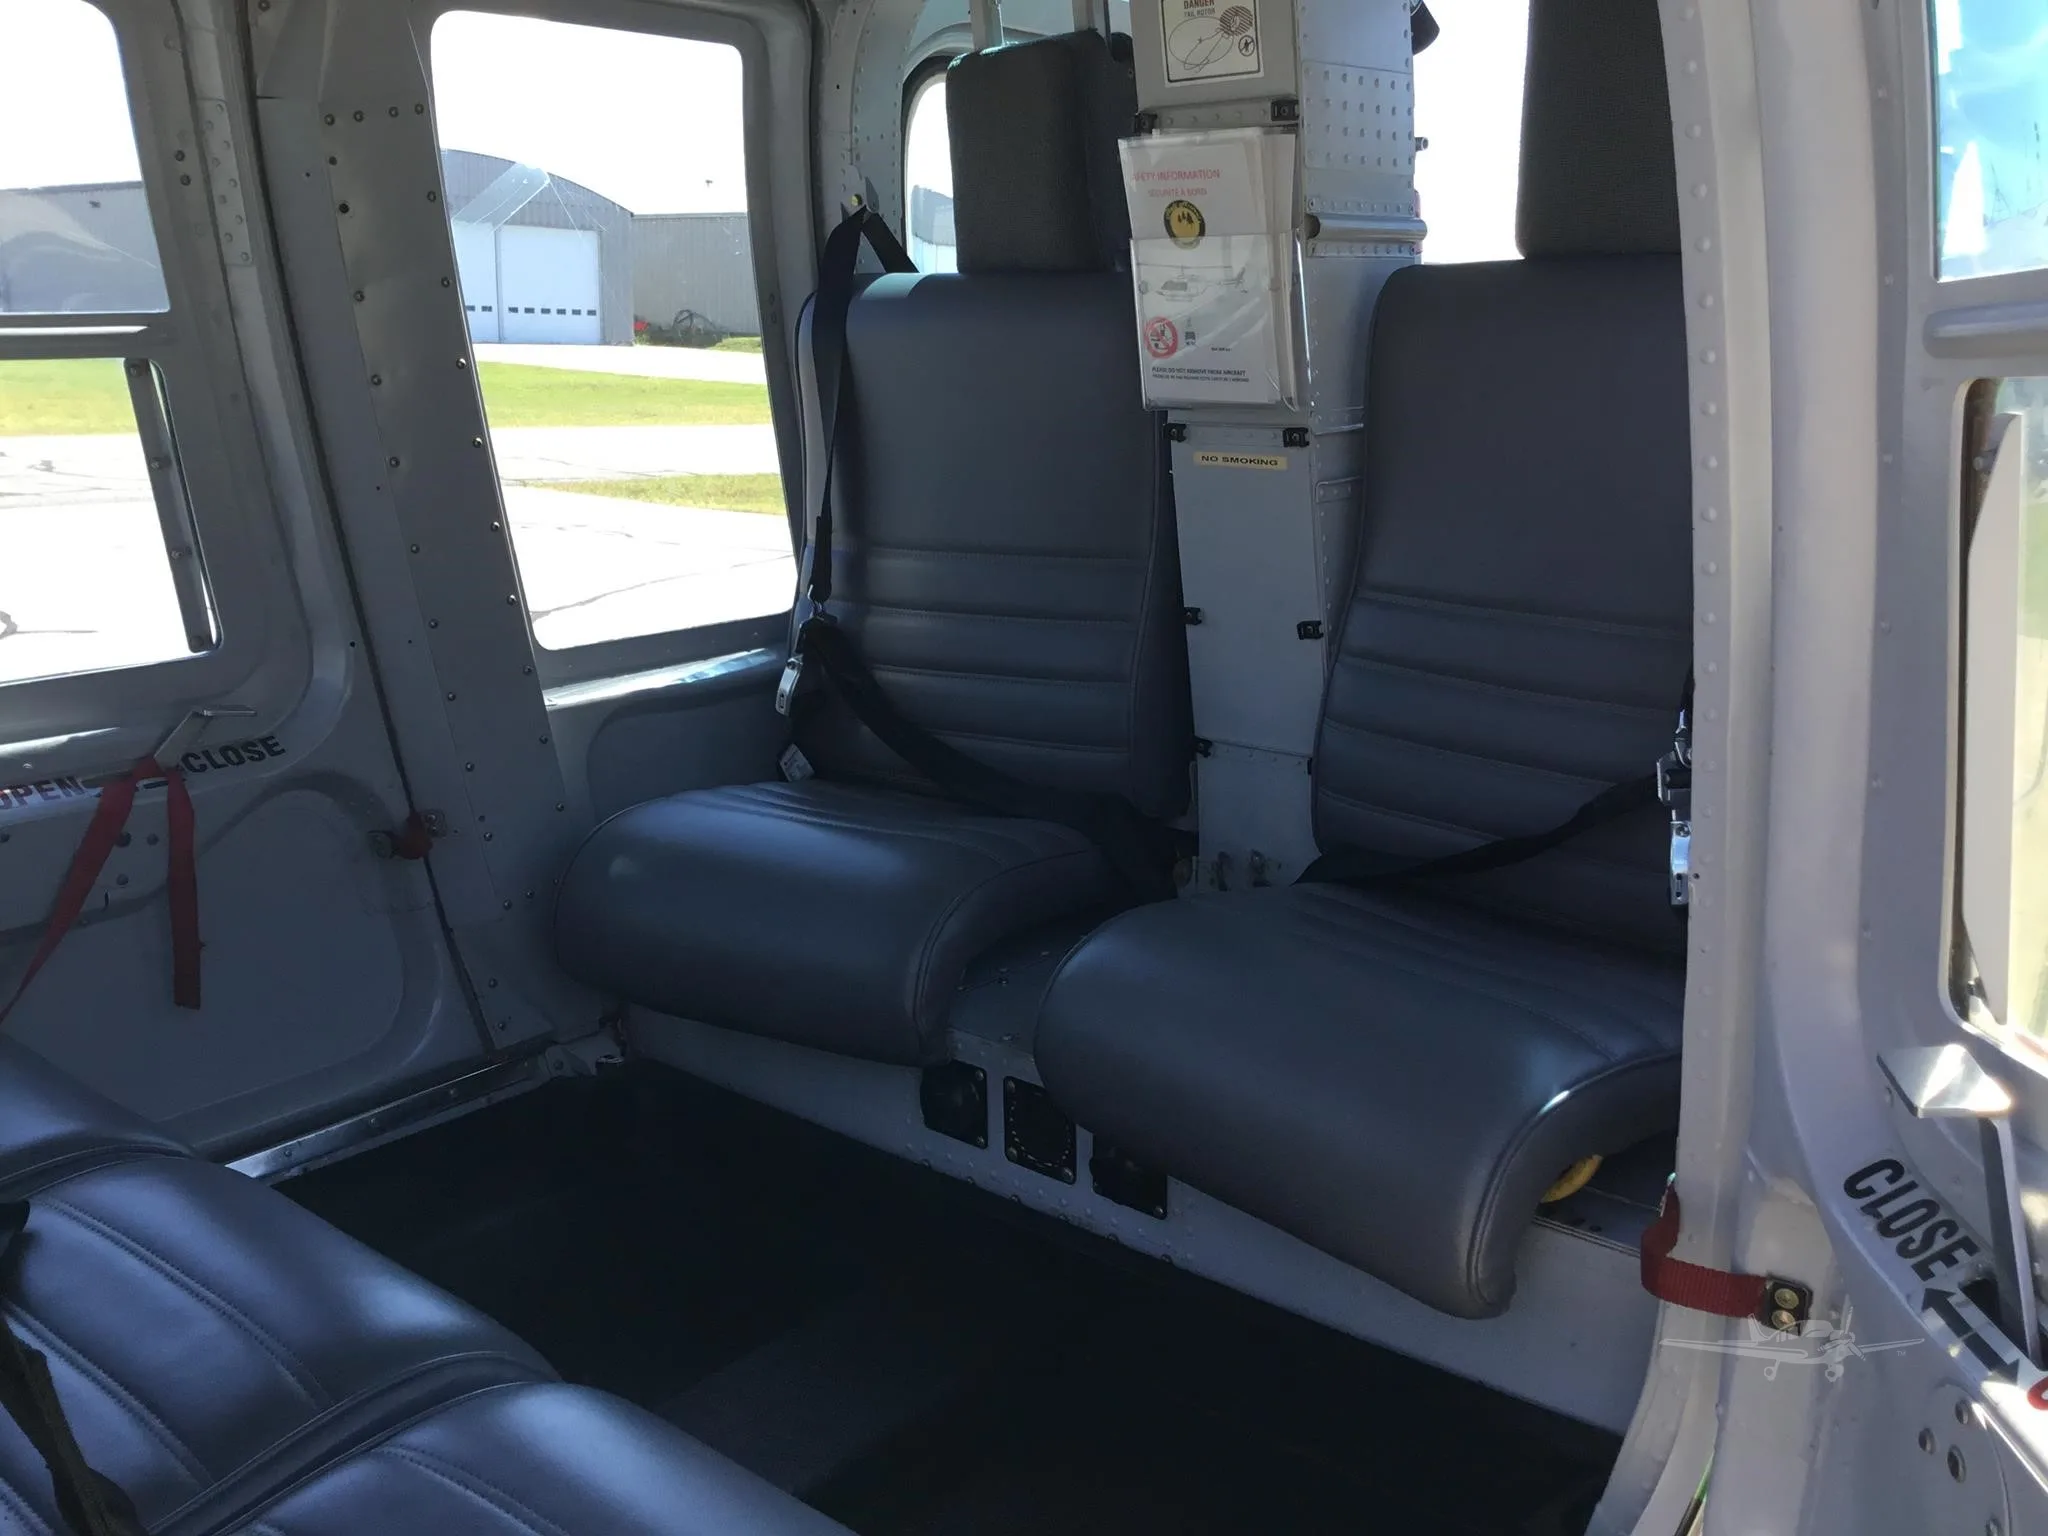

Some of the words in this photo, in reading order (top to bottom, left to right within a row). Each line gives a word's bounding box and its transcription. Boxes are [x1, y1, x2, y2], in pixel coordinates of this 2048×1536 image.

[1184, 0, 1215, 9] DANGER
[1197, 8, 1216, 16] ROTOR
[1132, 171, 1157, 181] AFETY
[1158, 168, 1220, 180] INFORMATION
[1222, 456, 1278, 466] SMOKING
[181, 735, 286, 773] CLOSE
[1843, 1158, 1980, 1282] CLOSE
